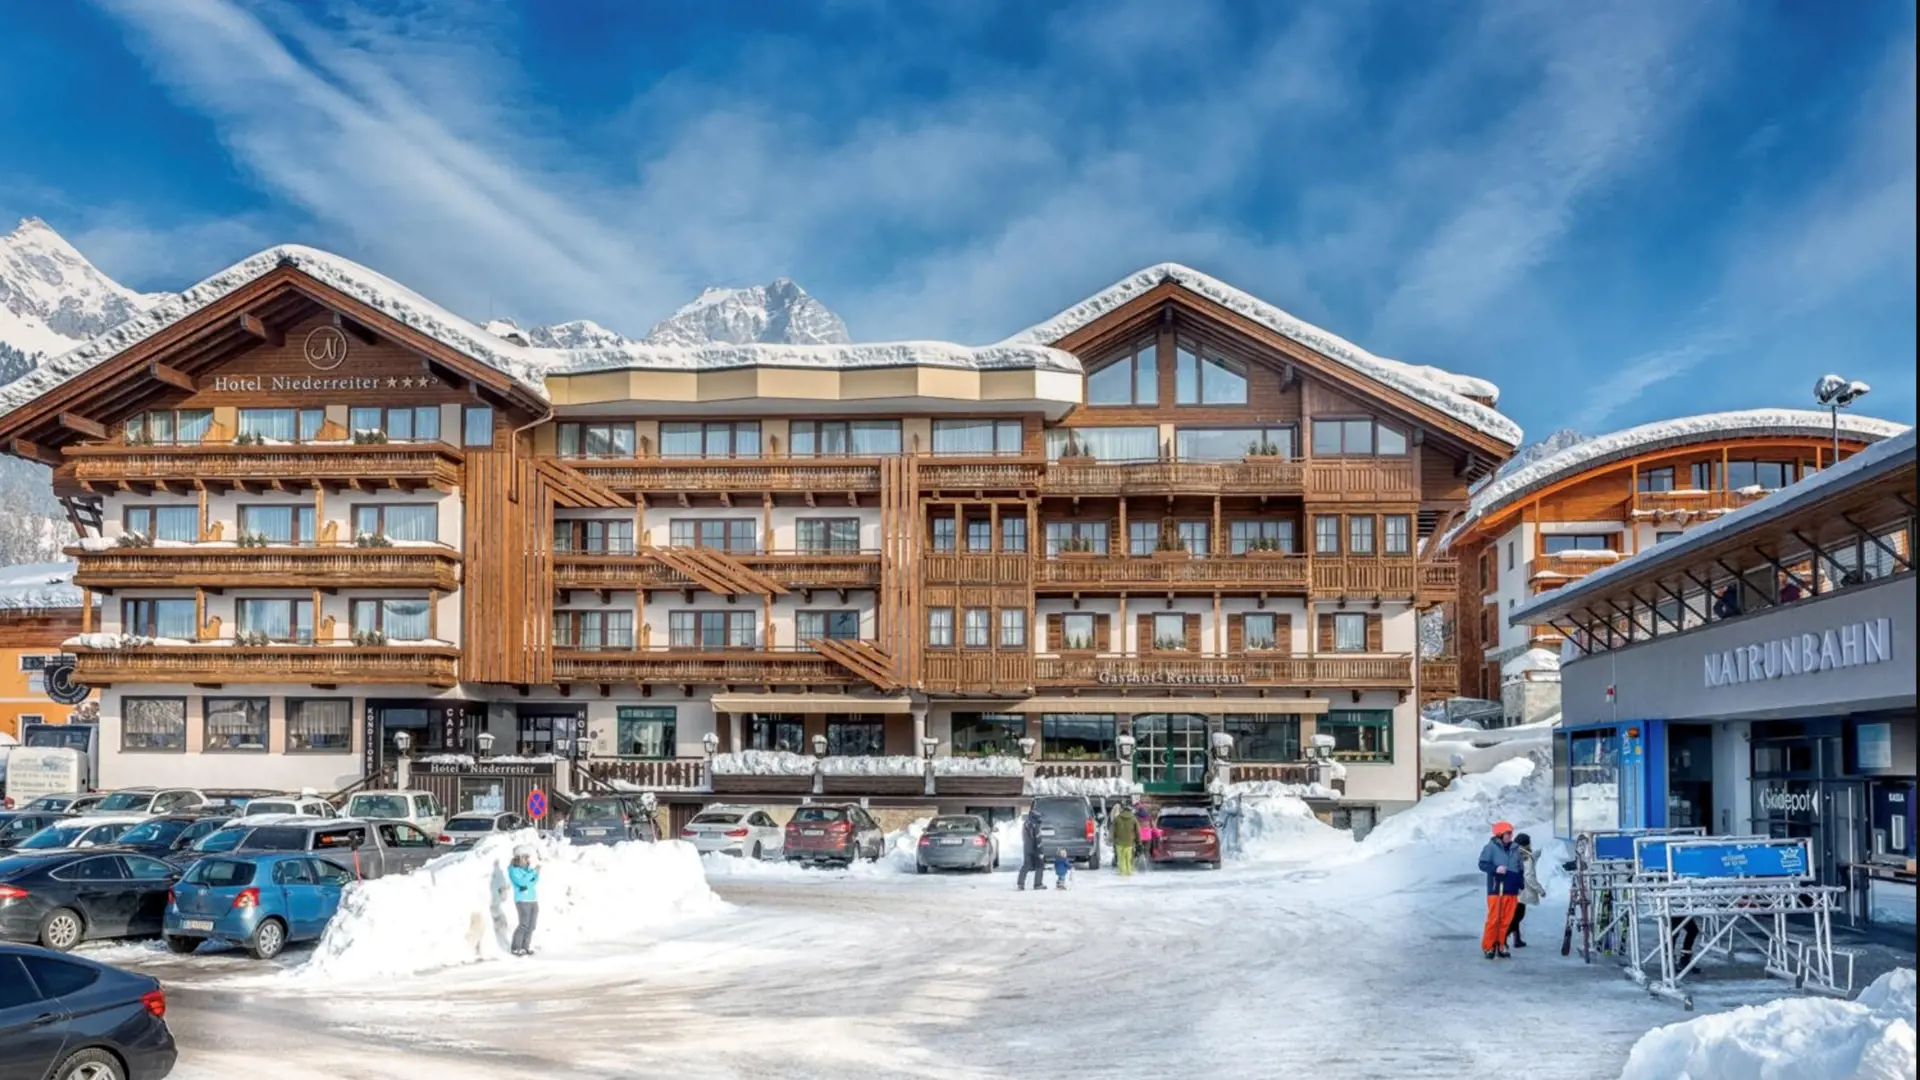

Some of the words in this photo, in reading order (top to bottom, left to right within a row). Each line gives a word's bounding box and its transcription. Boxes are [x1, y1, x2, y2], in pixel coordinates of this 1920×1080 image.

[215, 376, 262, 391] Hotel
[272, 376, 380, 391] Niederreiter
[1704, 617, 1893, 688] NATRUNBAHN
[367, 707, 375, 776] KONDITOREI
[577, 710, 585, 757] HOTL
[431, 763, 460, 773] Hotel
[470, 763, 535, 774] Niederreiter
[1765, 787, 1811, 816] Skidepot
